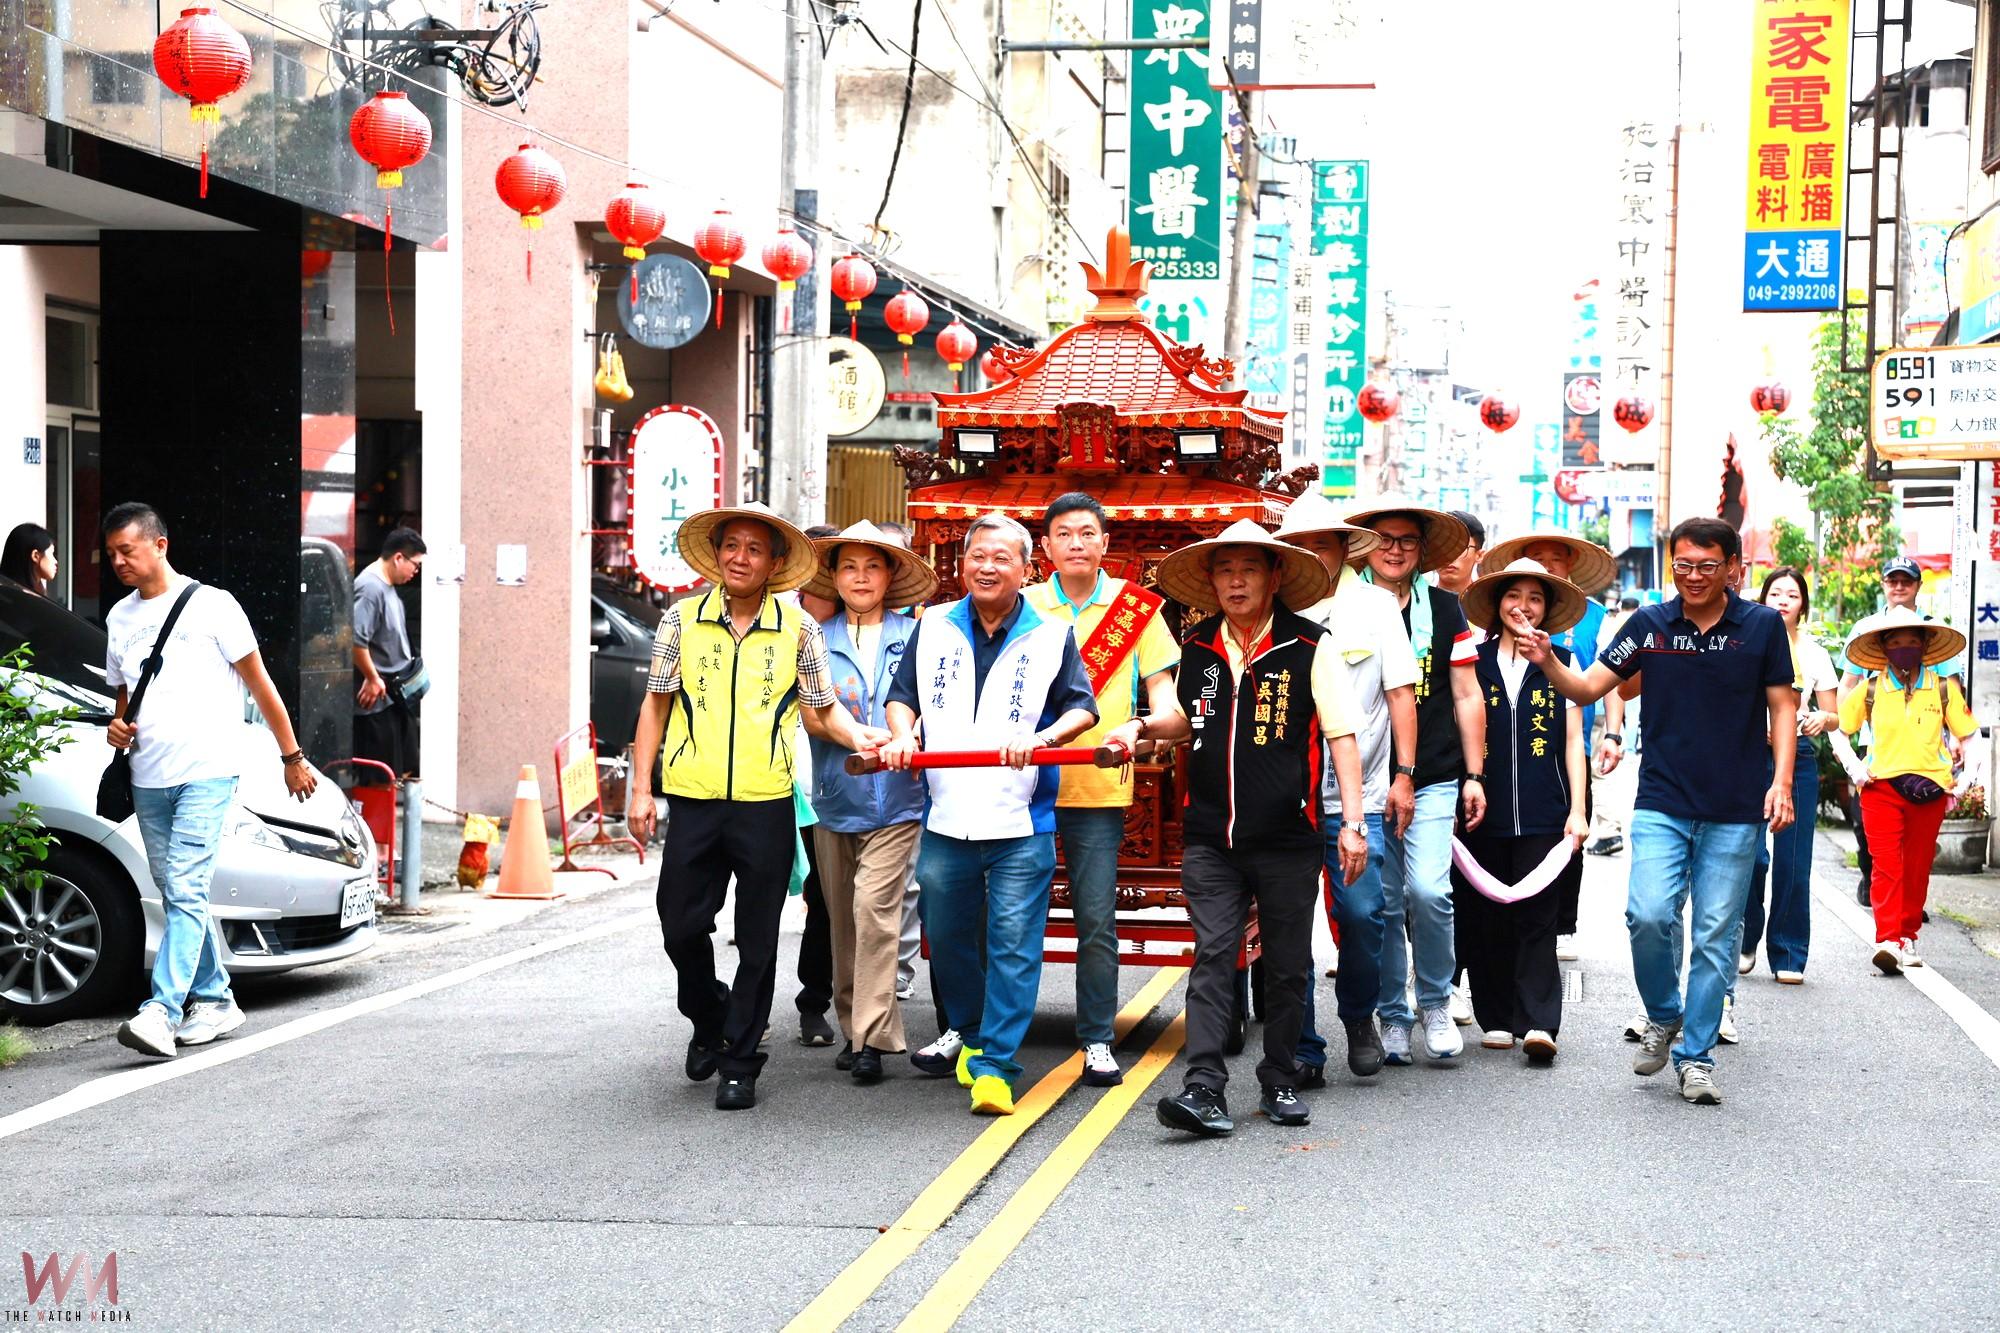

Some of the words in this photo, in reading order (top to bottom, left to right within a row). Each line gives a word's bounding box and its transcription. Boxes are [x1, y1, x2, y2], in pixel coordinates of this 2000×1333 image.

[1765, 12, 1832, 133] 家電
[1756, 144, 1790, 223] 電料
[1800, 142, 1836, 222] 廣播
[1755, 239, 1830, 280] 大通
[1748, 283, 1836, 302] 049-2992206
[1886, 357, 1935, 380] 8591
[1886, 387, 1935, 408] 591
[1950, 417, 1998, 432] 人力銀
[1608, 636, 1639, 666] CUM
[1977, 602, 2000, 662] 大通
[761, 645, 775, 710] 埔里鎮公所
[1274, 669, 1291, 740] 南投縣議員
[1253, 681, 1273, 746] 吳國昌
[1530, 689, 1548, 757] 馬文君
